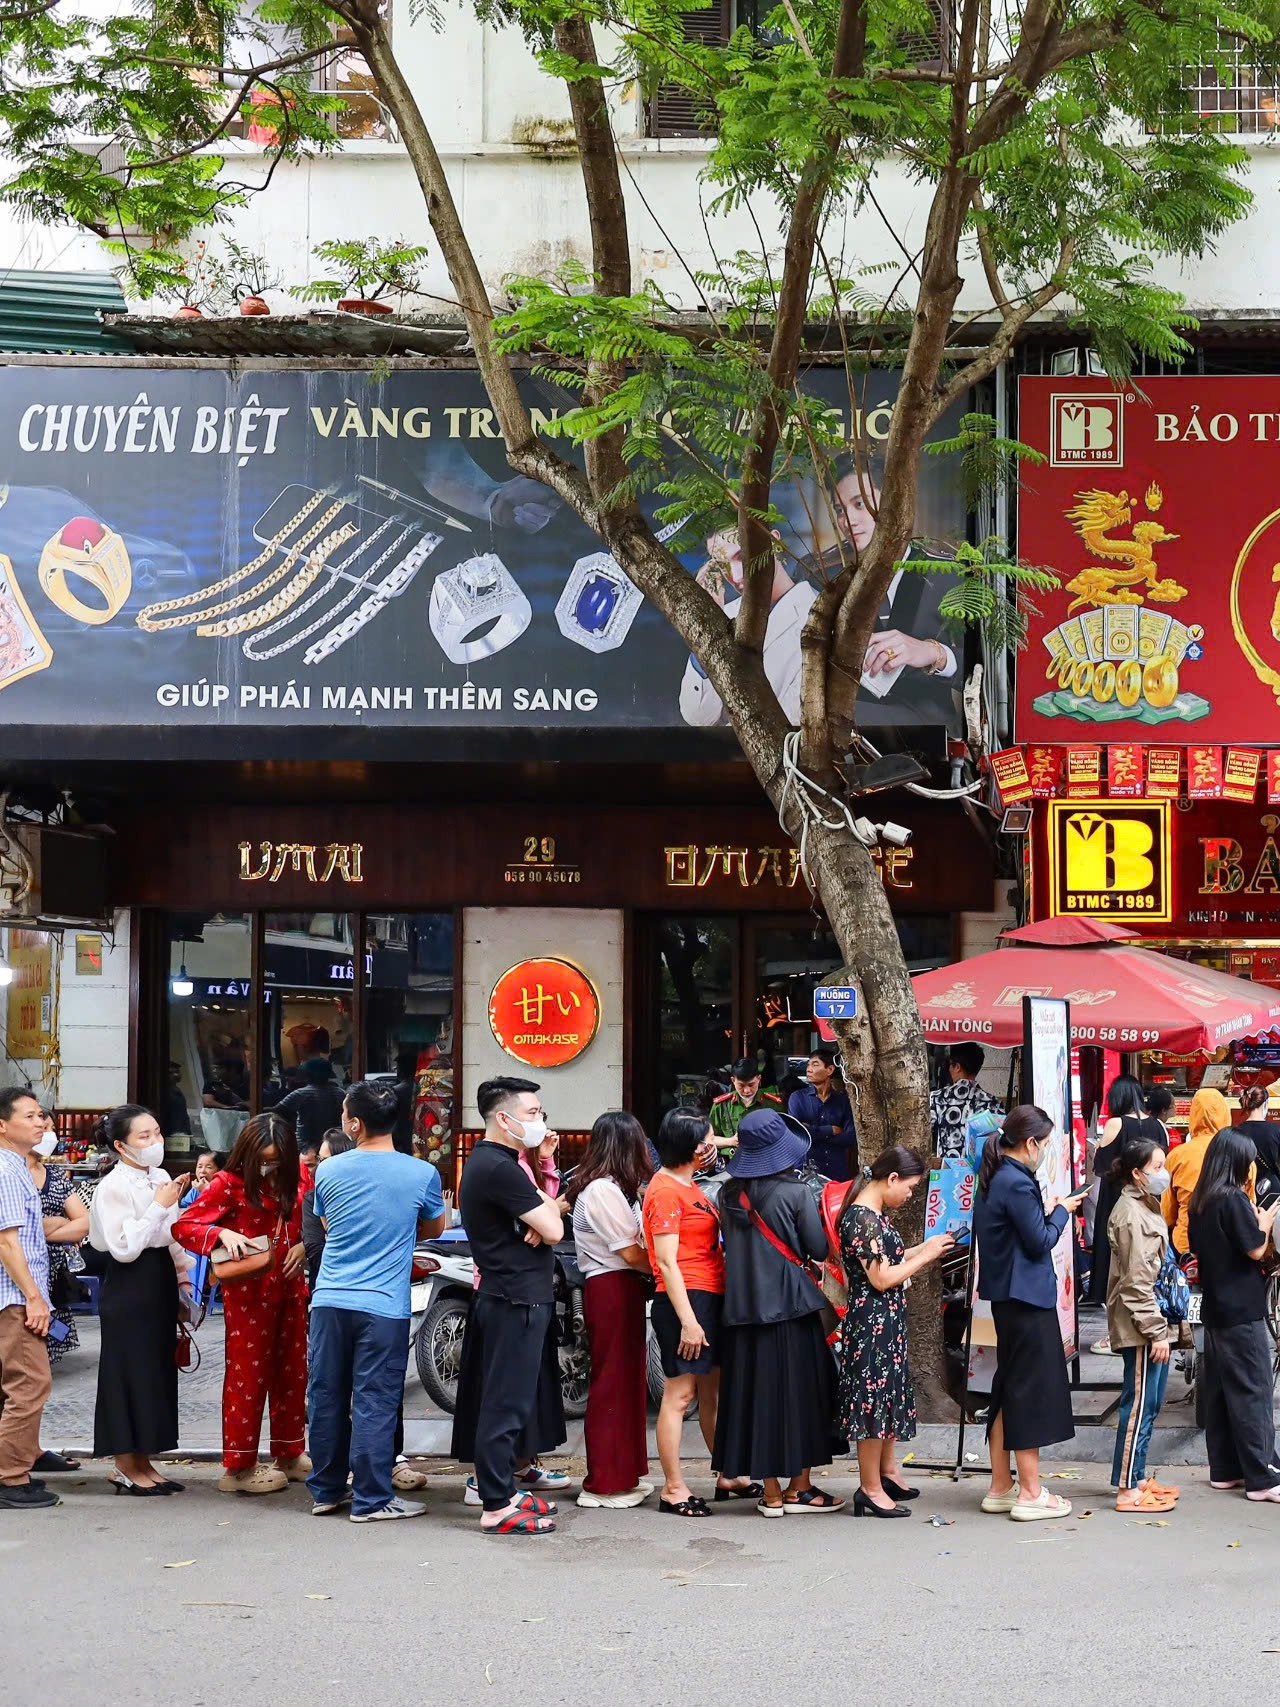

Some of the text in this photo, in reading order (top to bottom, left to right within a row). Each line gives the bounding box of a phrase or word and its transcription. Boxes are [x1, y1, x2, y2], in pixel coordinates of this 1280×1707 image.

[311, 398, 431, 439] VÀNG
[1155, 405, 1239, 442] BẢO
[18, 392, 289, 467] CHUYÊN BIỆT
[1061, 450, 1113, 459] BTMC 1989
[157, 678, 599, 715] GIÚP PHÁI MẠNH THÊM SANG
[523, 836, 555, 862] 29
[529, 871, 542, 882] 90
[1067, 894, 1155, 908] BTMC 1989
[513, 984, 581, 1025] 甘い
[828, 1004, 845, 1014] 17
[921, 1017, 993, 1034] HÂN TÔNG
[1070, 1028, 1159, 1043] 800 58 58 99
[513, 1034, 579, 1044] OMAKASE
[959, 1174, 974, 1211] laVie
